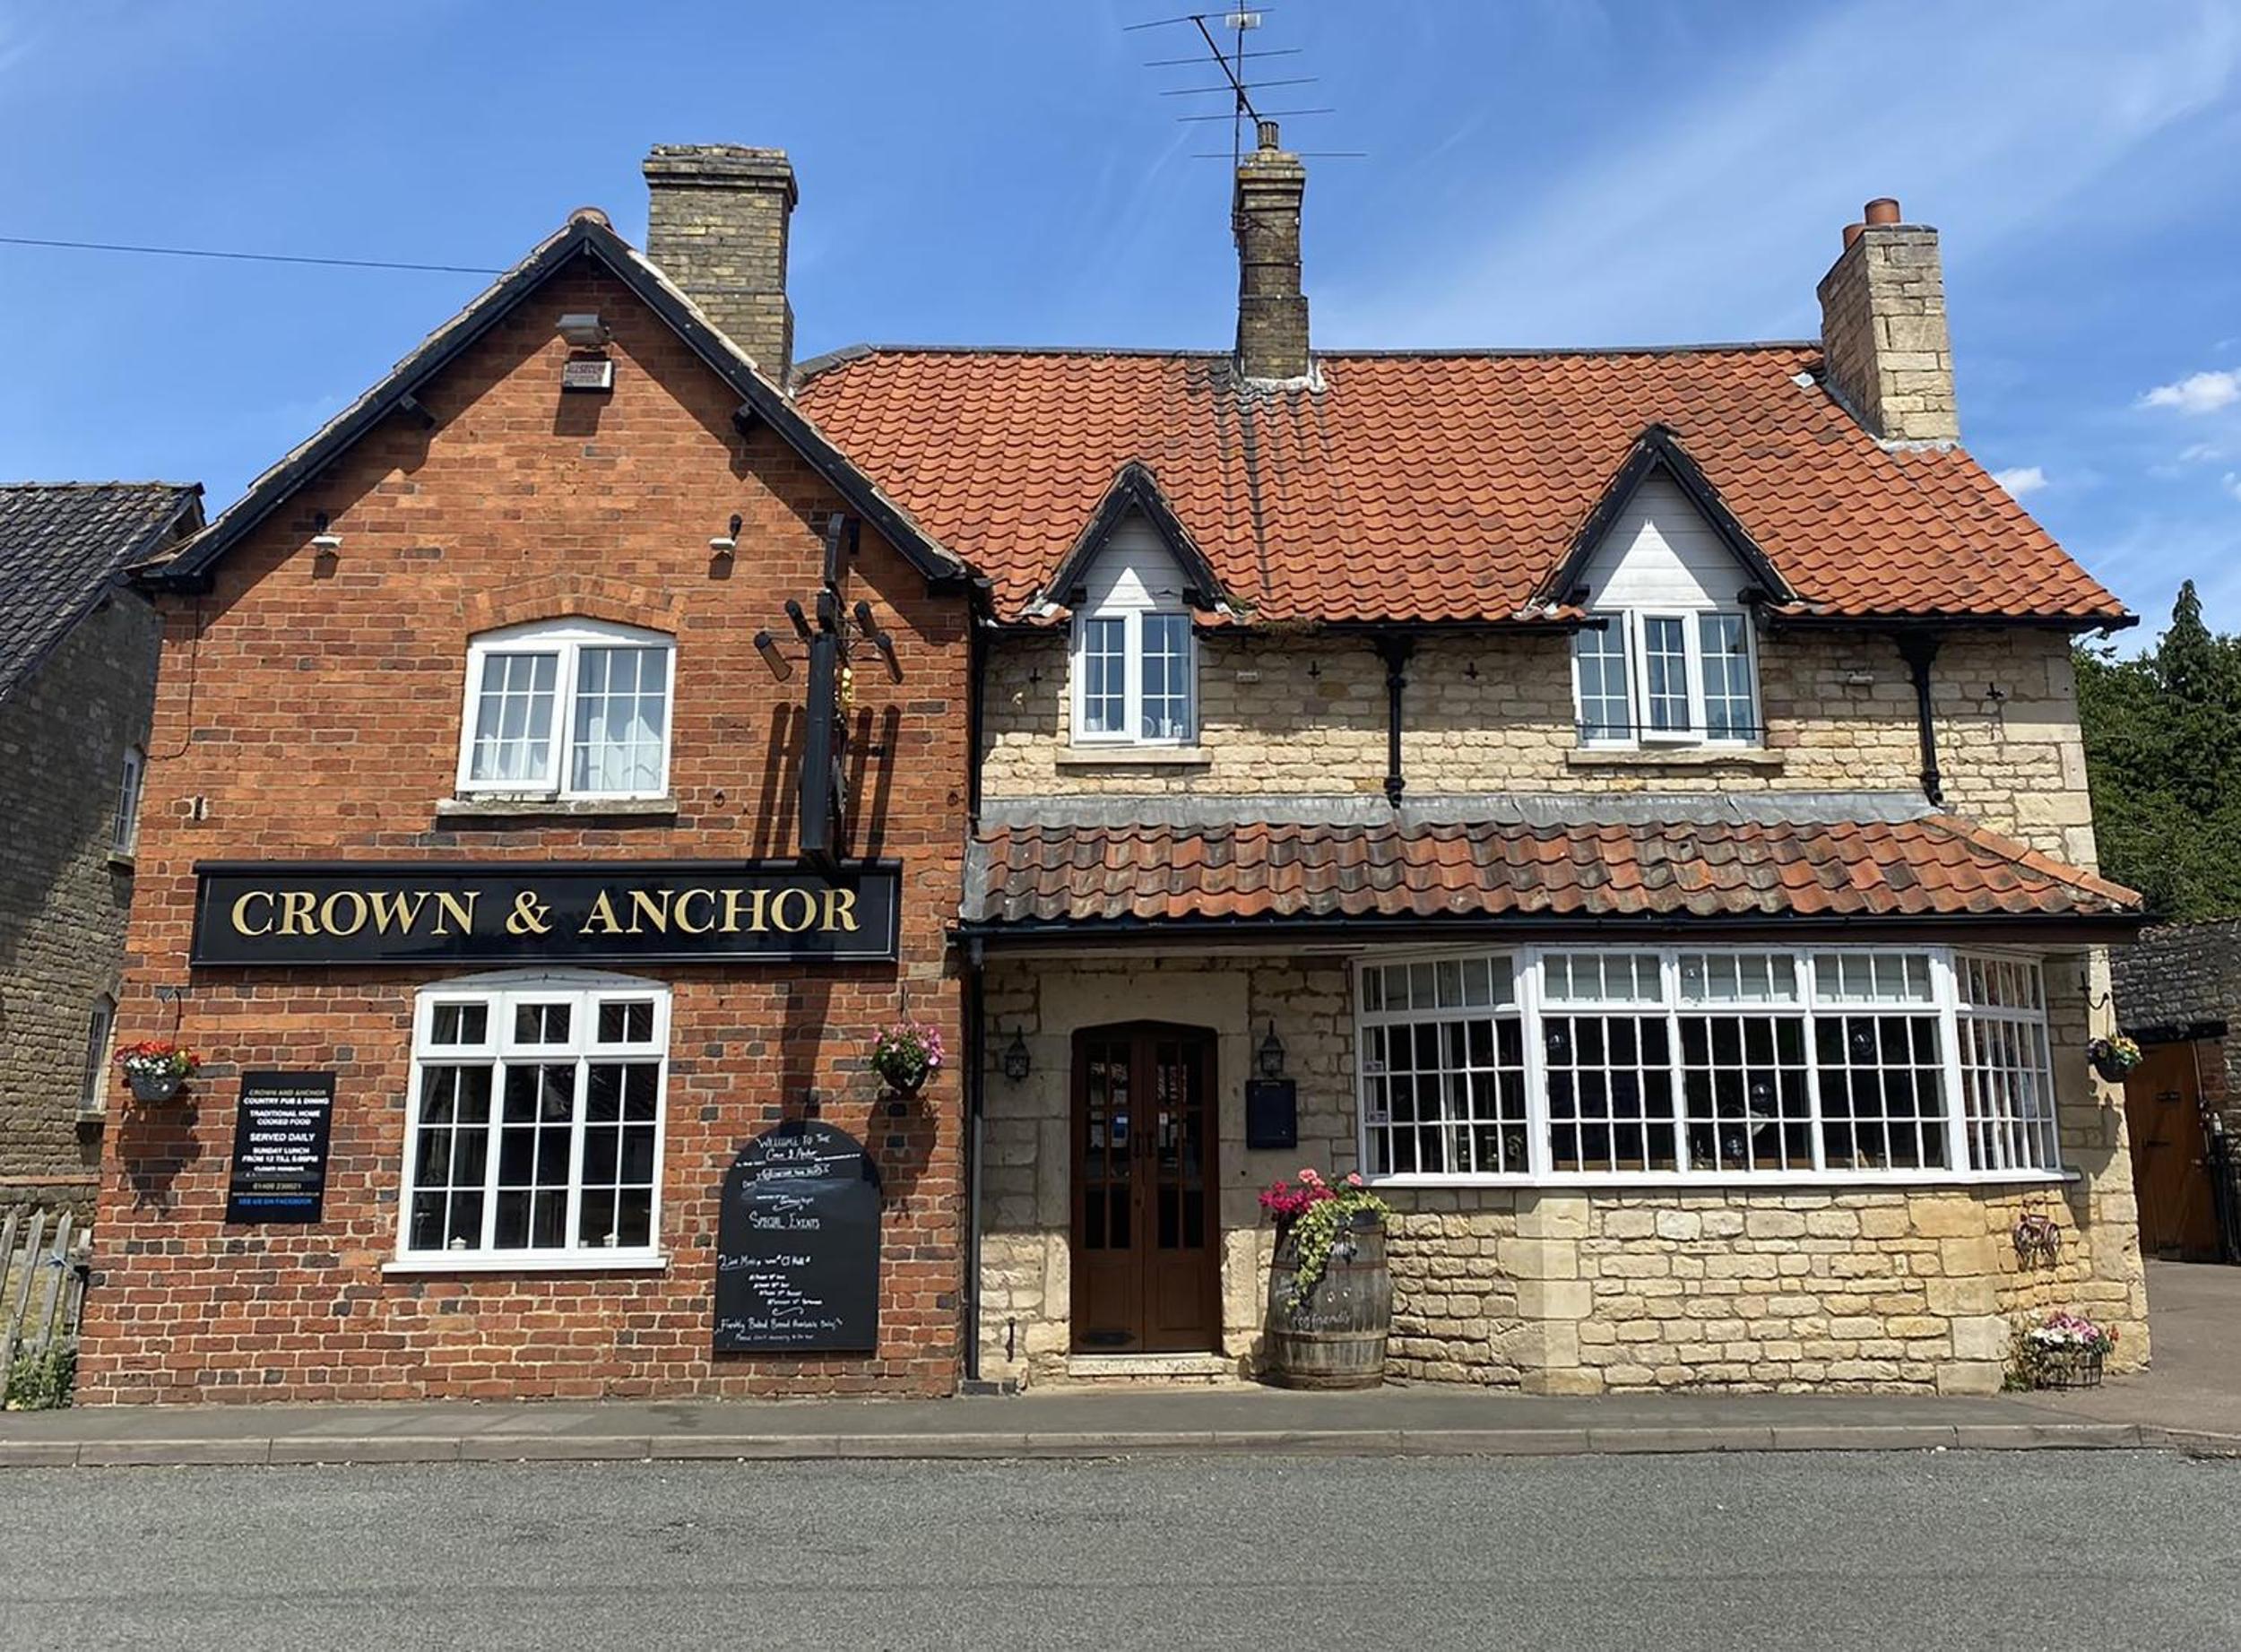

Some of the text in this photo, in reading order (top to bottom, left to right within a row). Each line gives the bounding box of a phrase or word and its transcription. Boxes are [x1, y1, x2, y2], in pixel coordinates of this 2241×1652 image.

[230, 887, 861, 937] CROWN & ANCHOR
[298, 1110, 321, 1118] HOME
[256, 1118, 289, 1126] COOKED
[249, 1133, 316, 1142] SERVED DAILY
[253, 1146, 310, 1155] SUNDAY LUNCH
[241, 1155, 264, 1163] FROM
